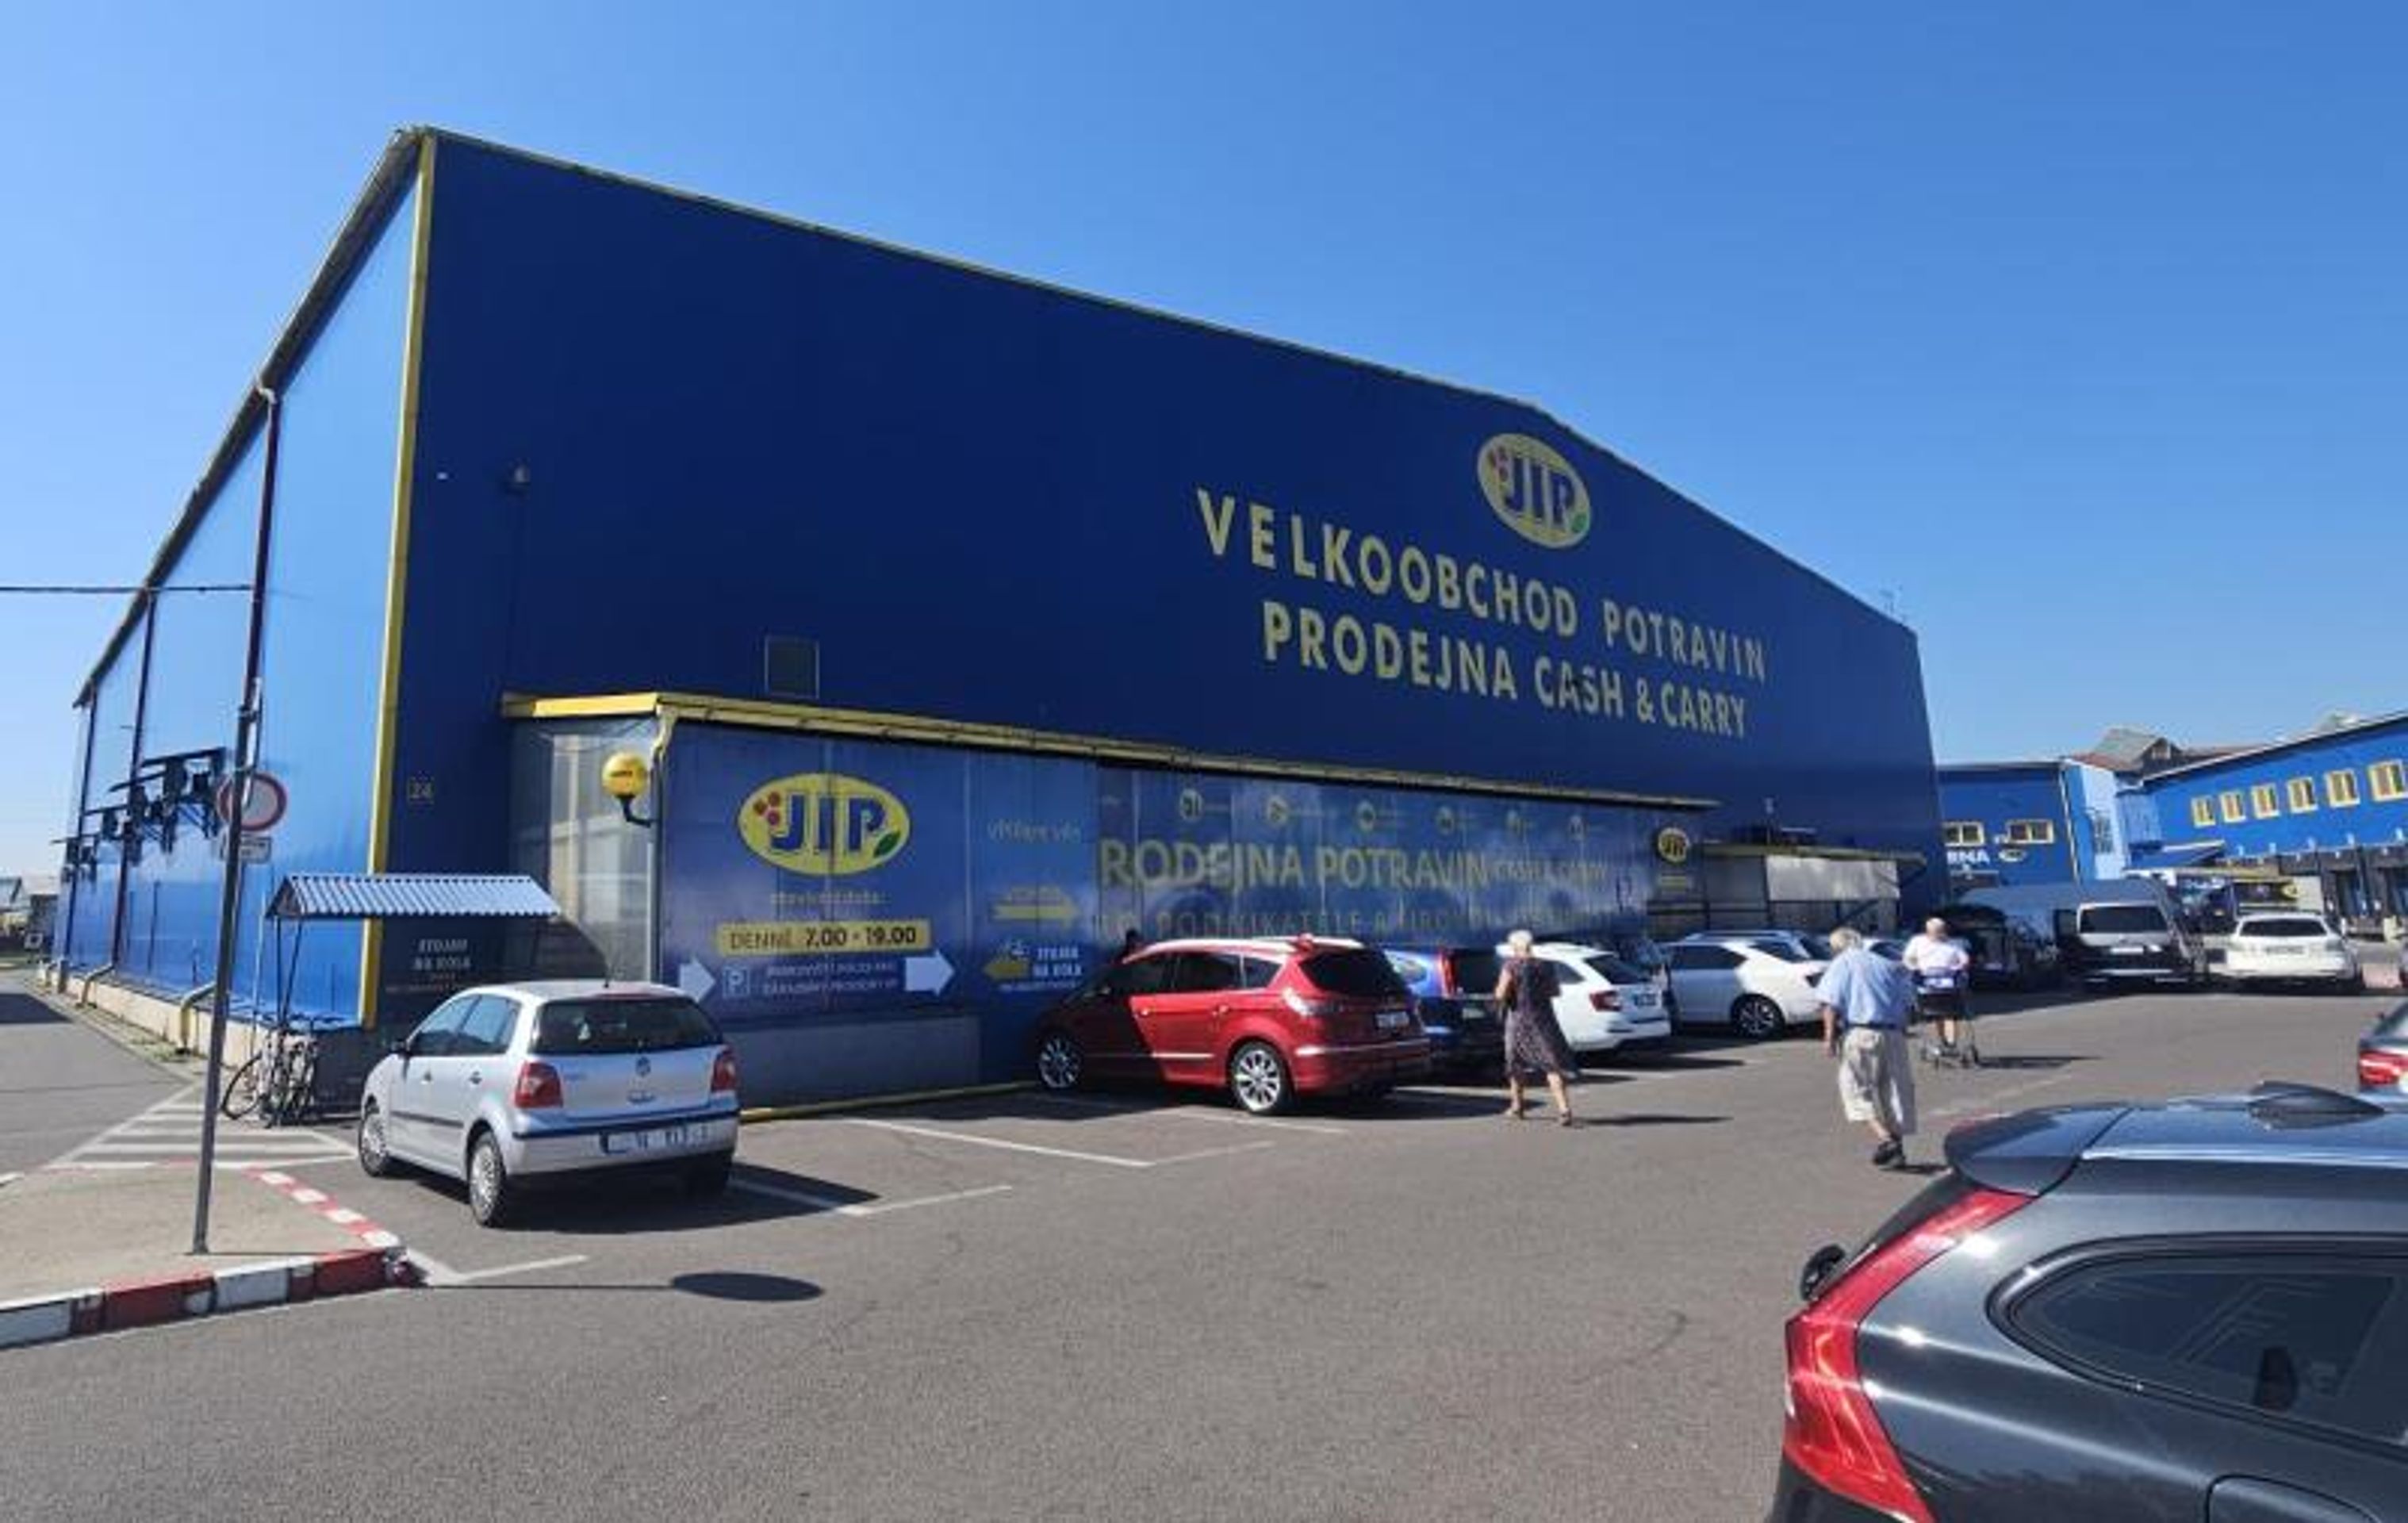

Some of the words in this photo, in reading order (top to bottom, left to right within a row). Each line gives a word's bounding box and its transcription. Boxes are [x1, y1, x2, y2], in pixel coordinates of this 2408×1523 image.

[1504, 455, 1578, 531] JIP
[1196, 489, 1577, 637] VELKOOBCHOD
[1603, 600, 1766, 682] POTRAVIN
[1263, 601, 1518, 700] PRODEJNA
[1534, 657, 1624, 719] CASH
[1635, 677, 1656, 724] &
[1661, 683, 1746, 738] CARRY
[768, 792, 889, 855] JIP
[1317, 847, 1489, 890] POTRAVIN
[806, 926, 846, 947] 7.00
[866, 926, 917, 946] 19.00
